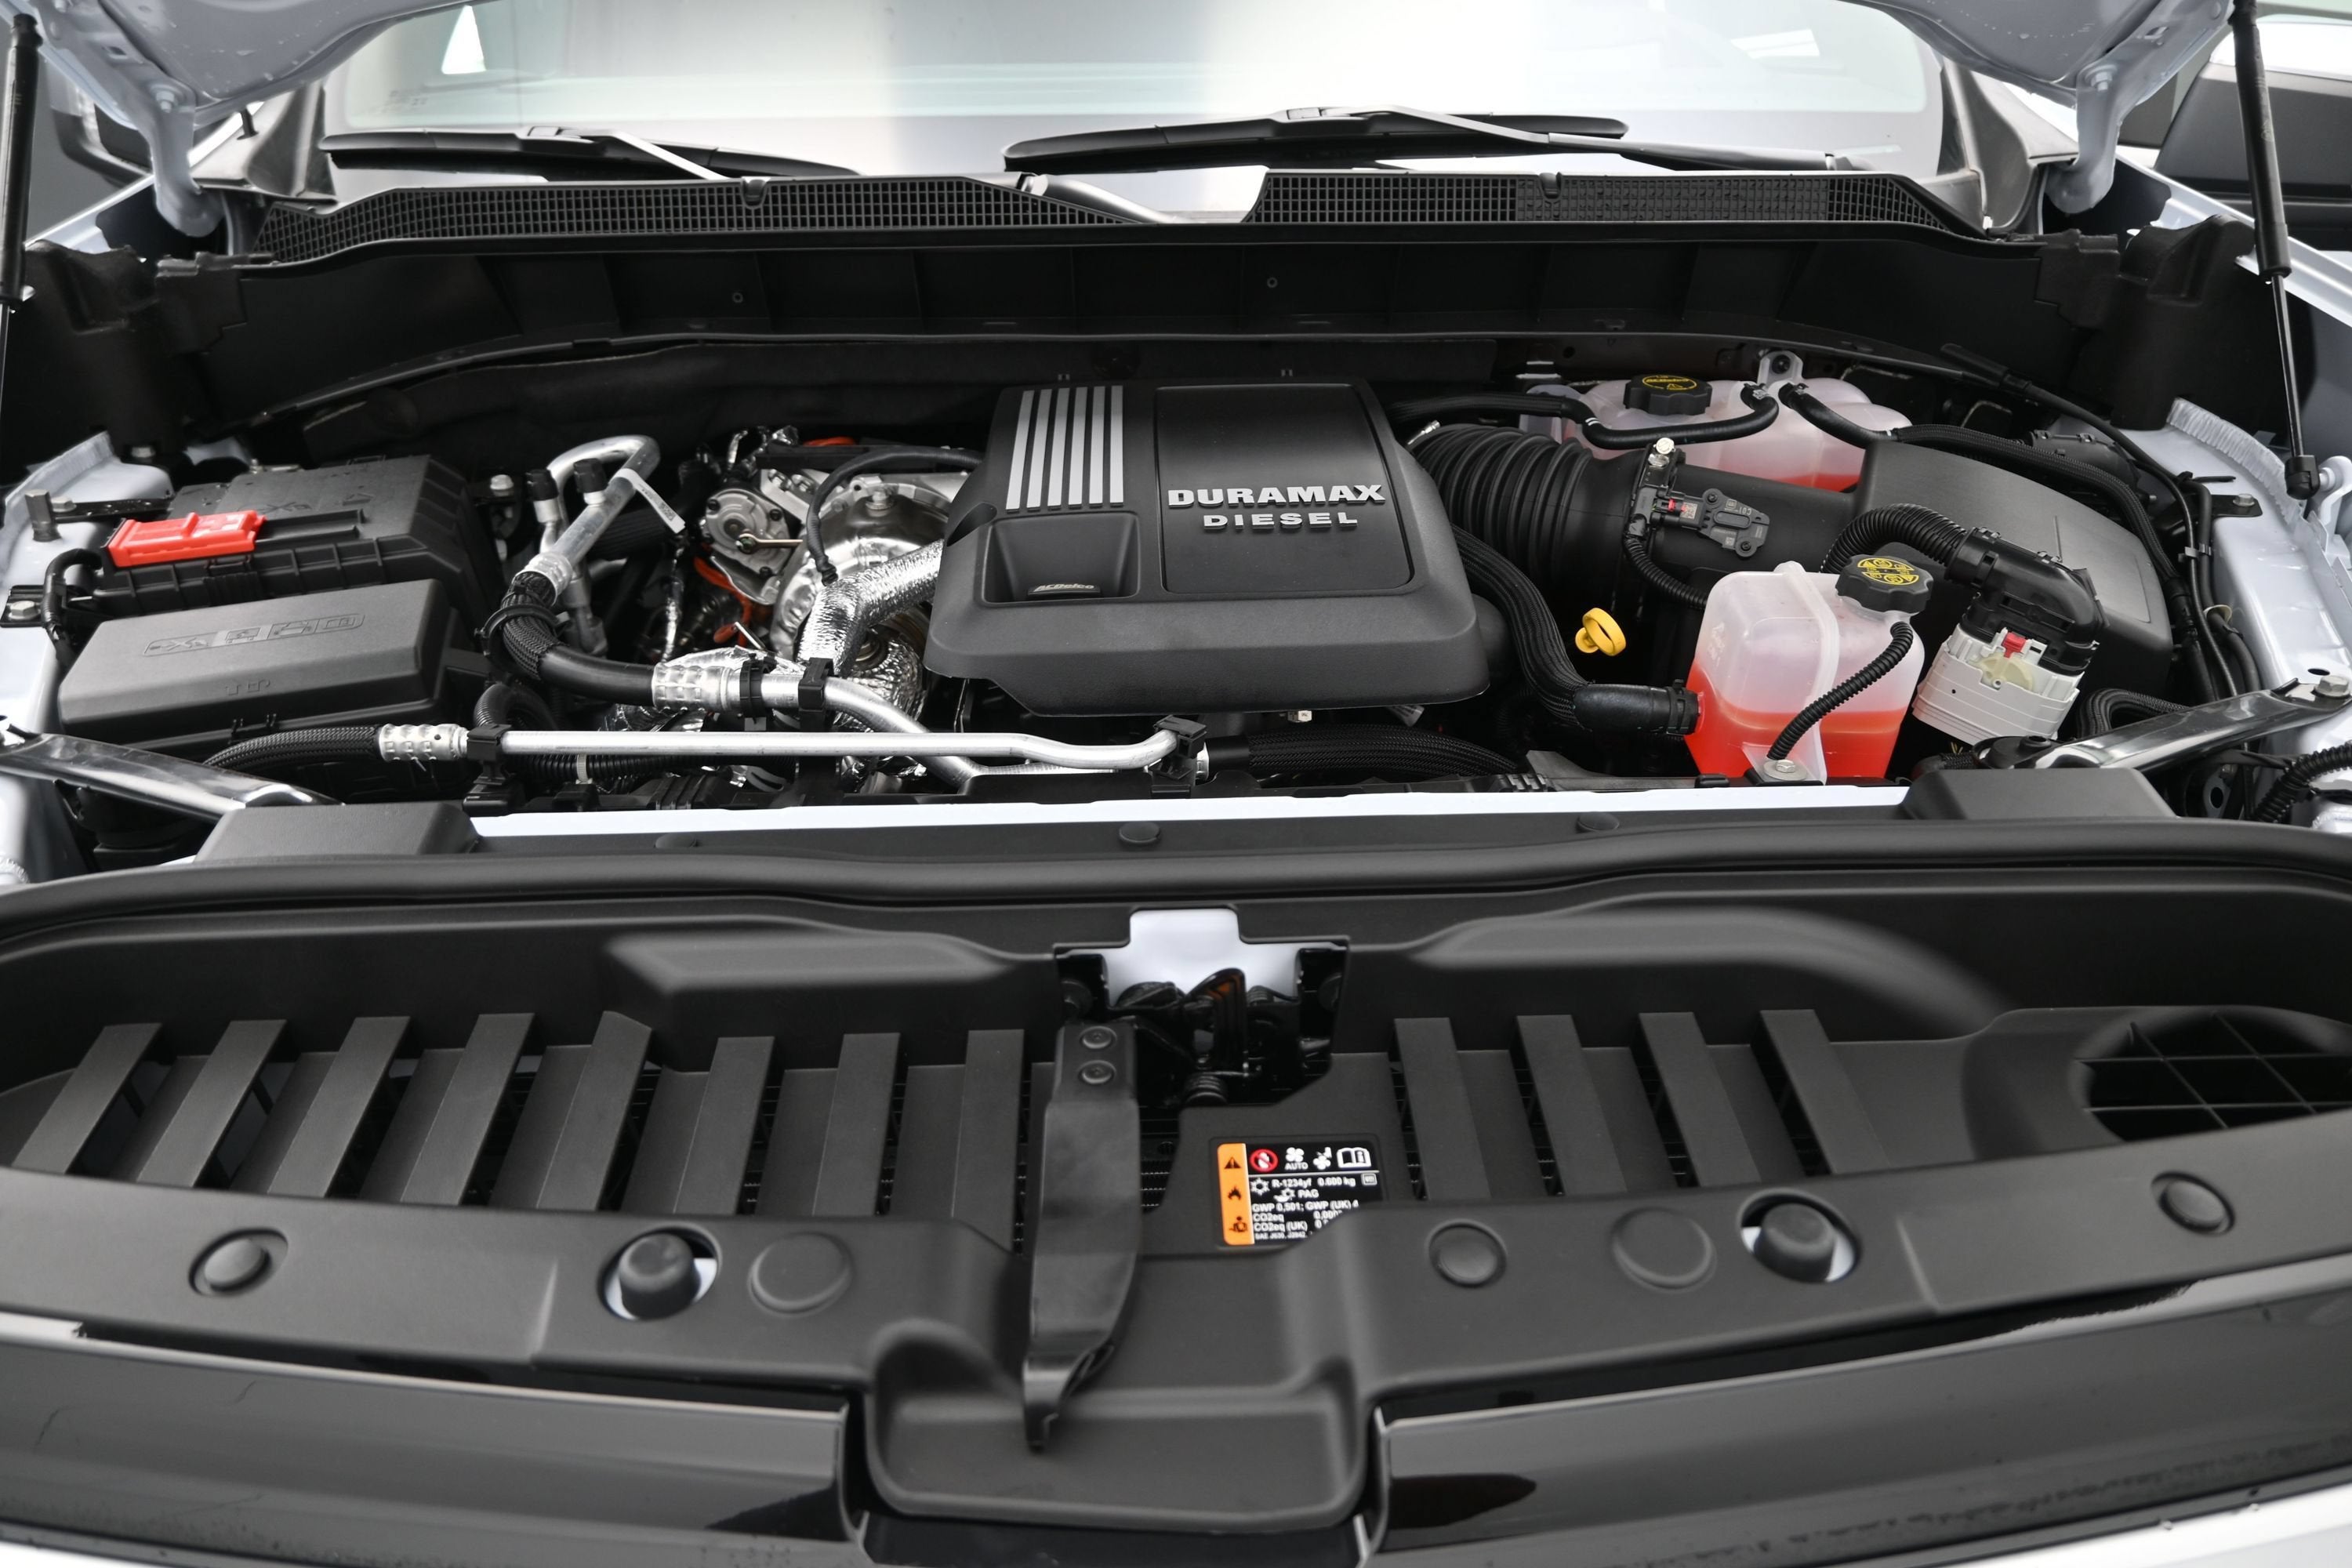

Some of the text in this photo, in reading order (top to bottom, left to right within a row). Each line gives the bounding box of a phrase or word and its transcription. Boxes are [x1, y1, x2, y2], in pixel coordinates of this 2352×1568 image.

[1168, 485, 1386, 508] DURAMAX
[1203, 512, 1358, 530] DIESEL
[1033, 583, 1094, 592] ACDelco
[1284, 1162, 1308, 1171] AUTO
[1271, 1178, 1312, 1189] R-1234yf
[1343, 1177, 1356, 1188] kg
[1298, 1189, 1319, 1199] PAG
[1252, 1203, 1275, 1213] GWP
[1305, 1200, 1329, 1211] GWP
[1330, 1200, 1352, 1210] (UK)
[1253, 1212, 1285, 1223] CO2eq
[1254, 1221, 1286, 1232] CO2eq
[1286, 1221, 1308, 1232] (UK)
